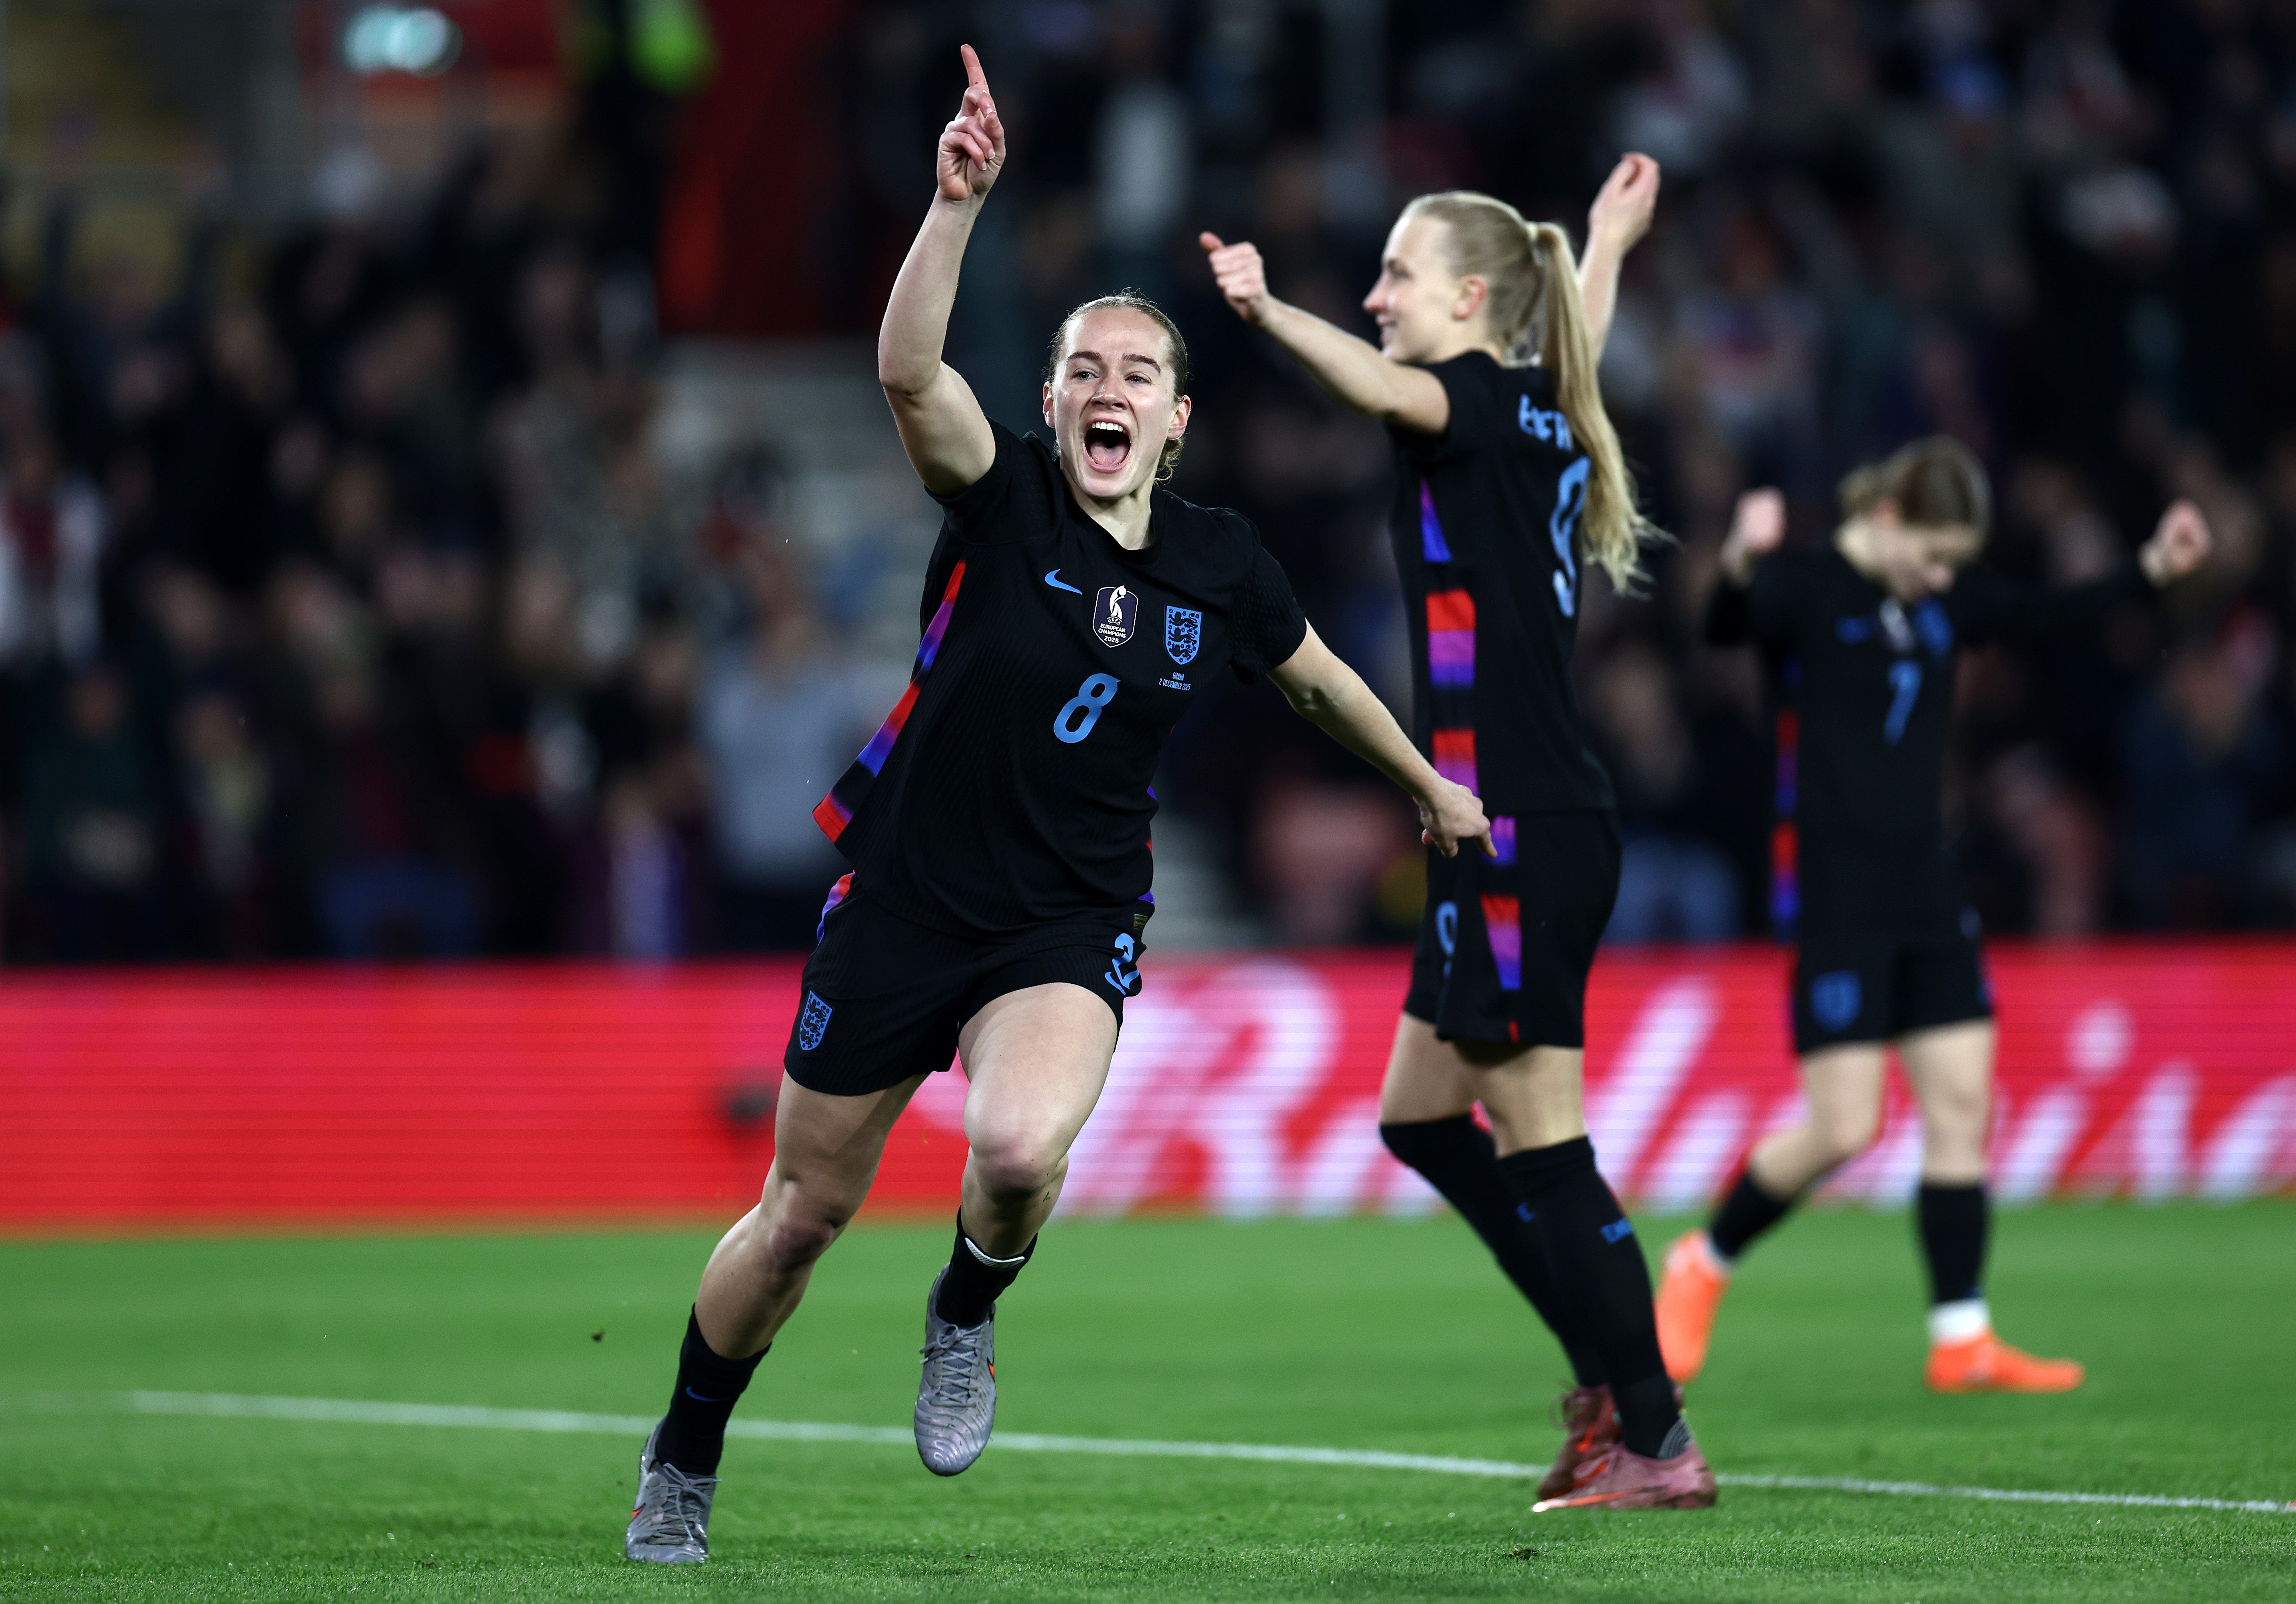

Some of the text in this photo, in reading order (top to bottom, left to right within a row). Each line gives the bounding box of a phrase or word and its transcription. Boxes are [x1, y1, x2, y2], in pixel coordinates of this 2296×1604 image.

[1550, 456, 1591, 618] 9
[1098, 628, 1126, 638] CHAMPIONS
[1100, 623, 1126, 633] EUROPEAN
[1172, 672, 1184, 681] GHANA
[1162, 678, 1182, 690] DECEMBER
[1181, 683, 1191, 691] 2025
[1053, 673, 1121, 743] 8
[1884, 660, 1923, 745] 7
